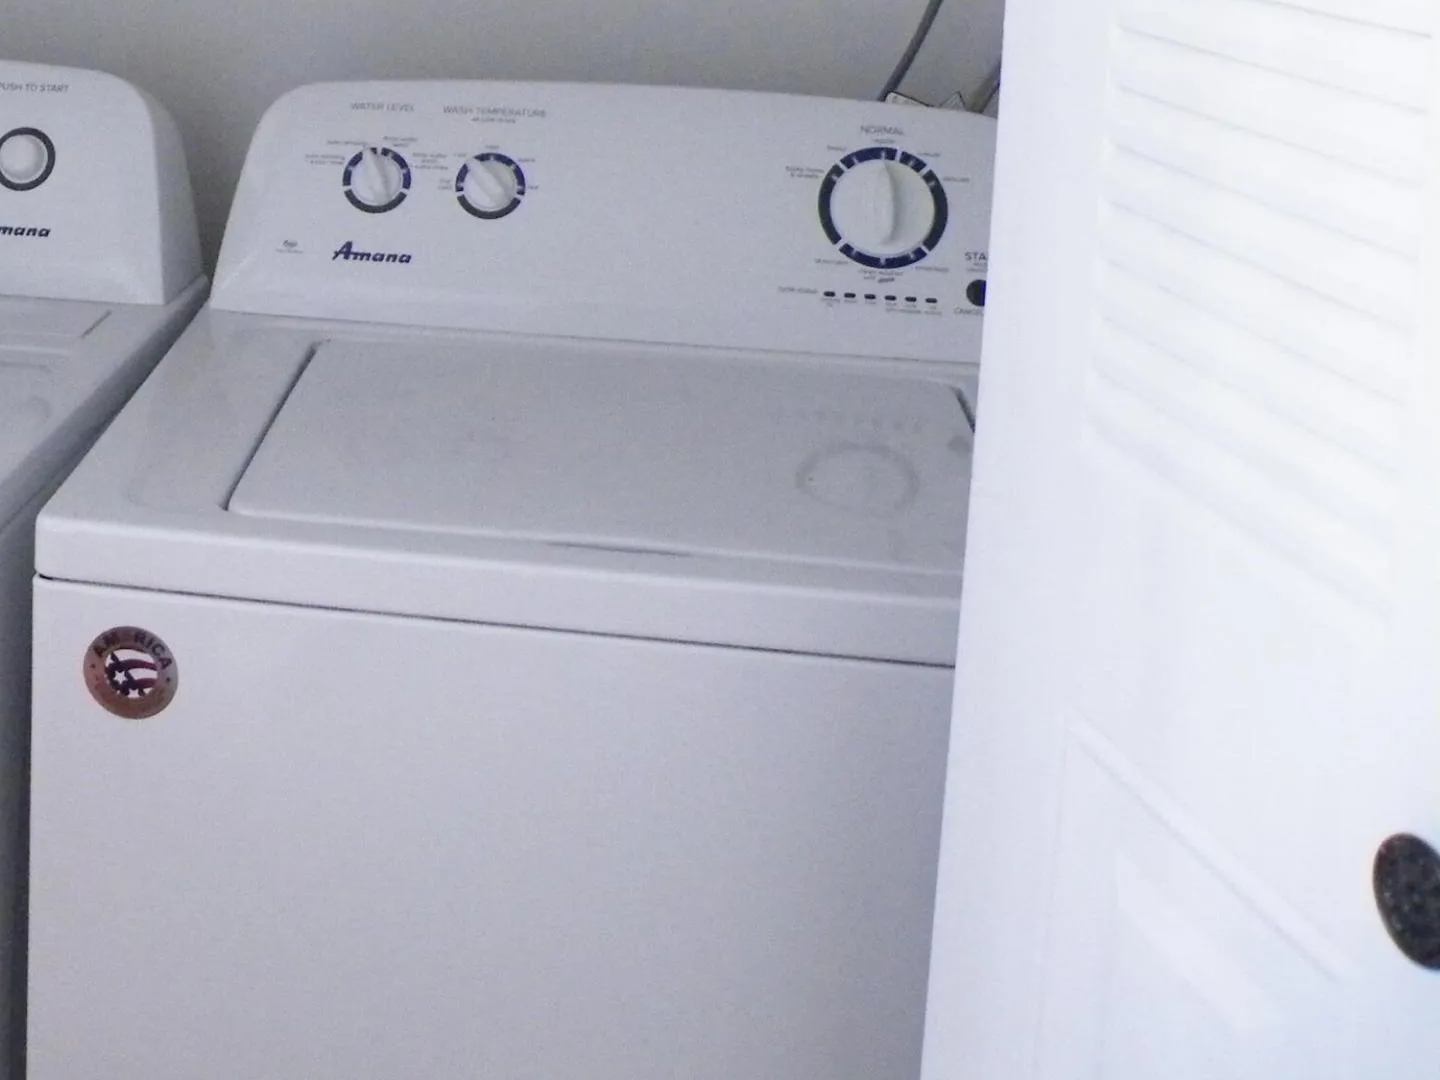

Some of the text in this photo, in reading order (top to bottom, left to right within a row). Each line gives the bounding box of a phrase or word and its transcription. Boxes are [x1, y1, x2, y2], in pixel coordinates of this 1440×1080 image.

[25, 83, 37, 92] TO
[39, 83, 70, 93] START
[350, 102, 415, 113] WATER LEVEL
[443, 106, 547, 119] WASH TEMPERATURE
[332, 240, 412, 264] Amana
[964, 252, 987, 261] STA
[93, 629, 172, 670] AMRICA
